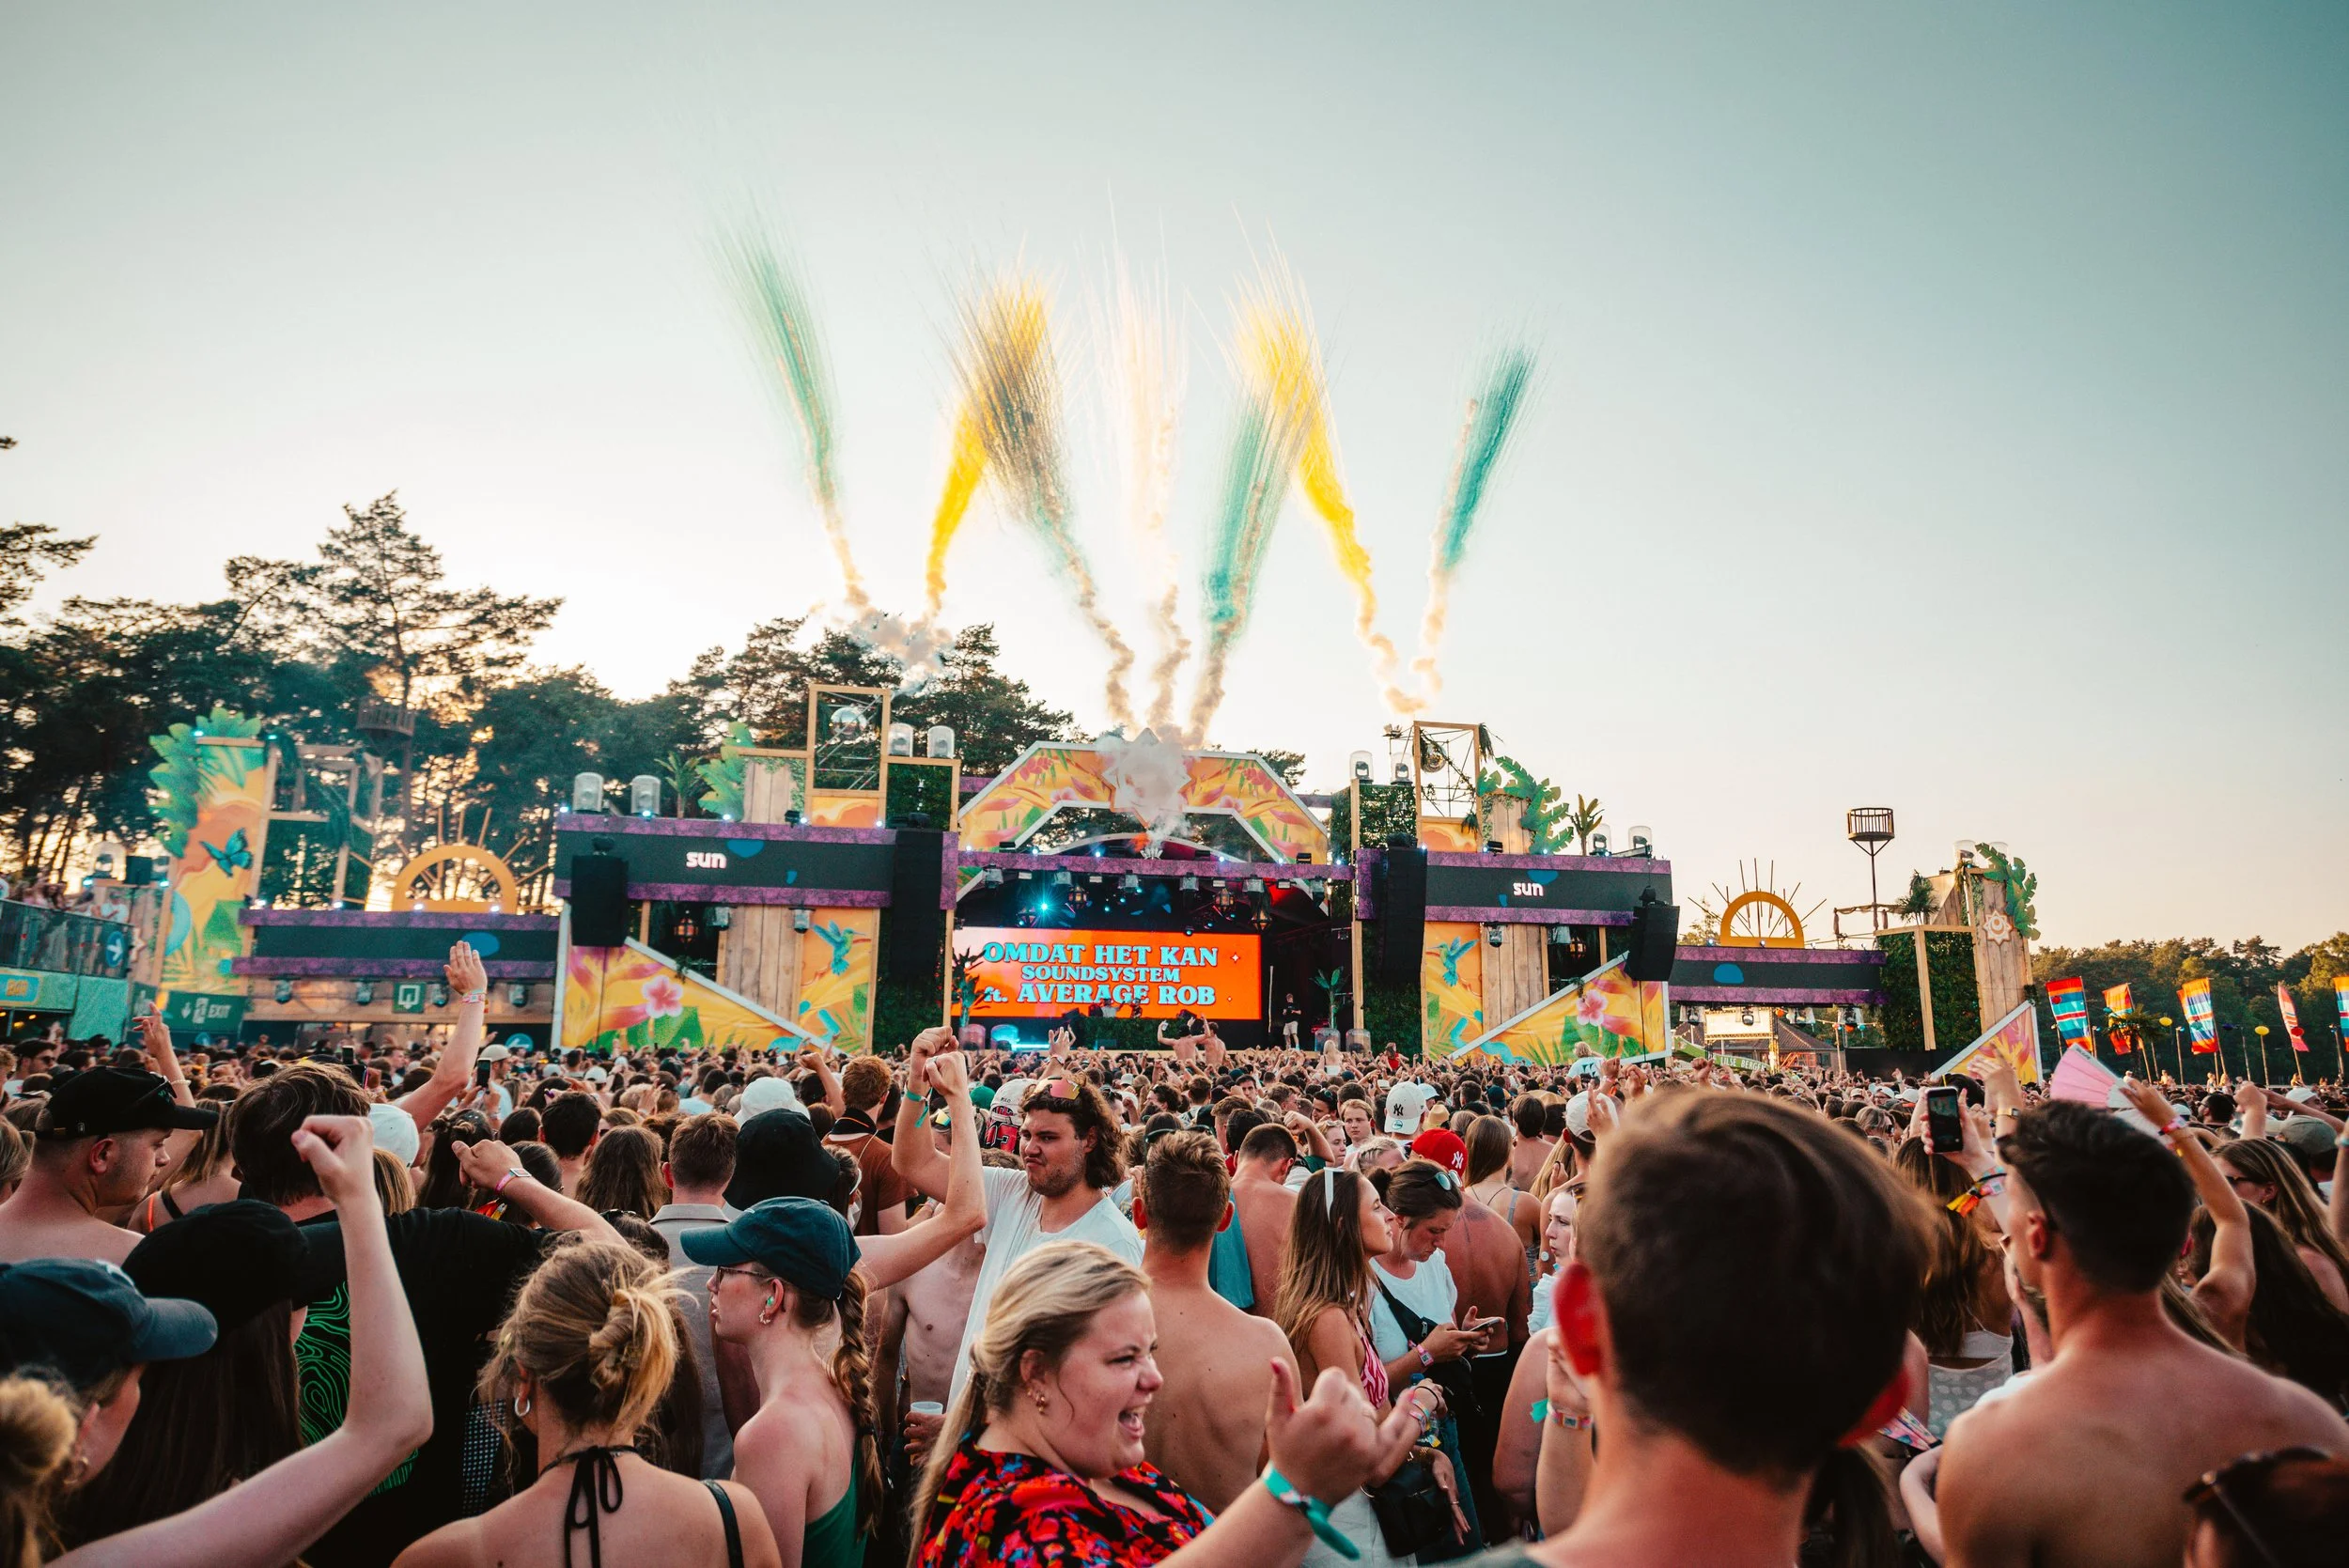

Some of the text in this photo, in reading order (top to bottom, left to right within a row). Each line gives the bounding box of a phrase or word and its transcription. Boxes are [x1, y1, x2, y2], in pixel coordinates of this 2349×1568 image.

[686, 851, 726, 869] sun
[1513, 882, 1544, 897] sun
[983, 941, 1219, 967] OMDAT HET KAN
[1021, 965, 1181, 983] SOUNDSYSTEM
[984, 983, 1216, 1005] ft. AVERAGE ROB
[208, 1004, 232, 1018] EXIT
[1392, 1102, 1404, 1117] NY
[1452, 1150, 1464, 1170] NY
